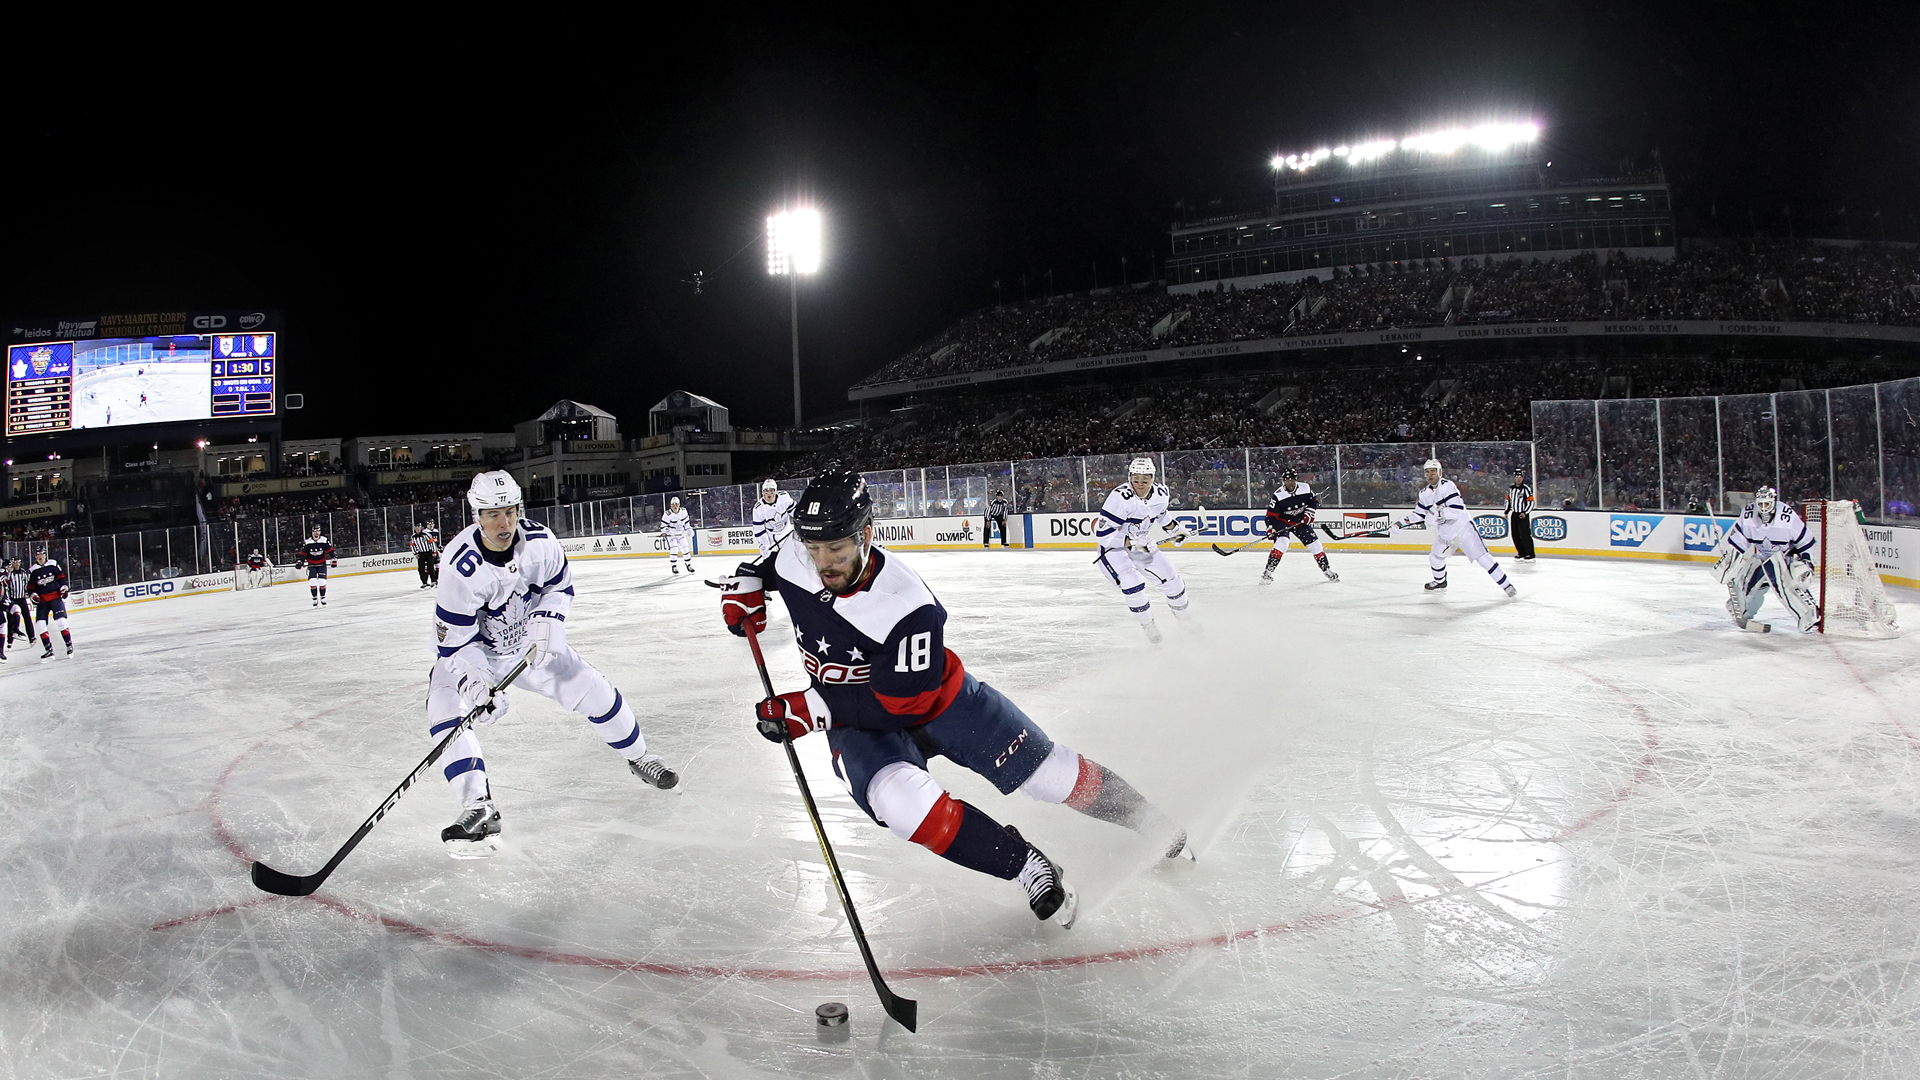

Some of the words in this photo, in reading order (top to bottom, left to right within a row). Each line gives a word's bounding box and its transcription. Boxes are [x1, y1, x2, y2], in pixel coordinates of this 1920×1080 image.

[100, 314, 158, 325] NAVY-MARINE
[160, 313, 187, 323] CORPS
[193, 316, 226, 328] GD
[58, 321, 80, 330] Navy
[100, 326, 146, 338] MEMORIAL
[148, 324, 185, 335] STADIUM
[1494, 327, 1532, 336] MISSILE
[1536, 326, 1568, 334] CRISIS
[1604, 325, 1645, 333] MEKONG
[24, 328, 52, 338] leidos
[64, 328, 95, 338] Mutual
[1380, 333, 1422, 341] LEBANON
[1301, 338, 1344, 346] PARALLEL
[1216, 345, 1240, 354] SIEGE
[264, 363, 270, 372] 5
[1076, 360, 1102, 368] CHOSIN
[1106, 355, 1147, 365] RESERVOIR
[215, 364, 221, 374] 2
[232, 363, 253, 373] 1:30
[300, 479, 329, 488] GEICO
[494, 478, 505, 486] 16
[16, 506, 52, 516] HONDA
[807, 502, 820, 515] 18
[1744, 504, 1754, 519] 35
[1780, 506, 1793, 522] 35
[1174, 516, 1268, 536] GEICO
[1346, 521, 1388, 529] CHAMPION
[1478, 517, 1504, 526] ROLD
[1537, 518, 1563, 527] ROLD
[519, 518, 549, 542] 16
[873, 526, 914, 541] ANADIAN
[1477, 526, 1506, 536] GOLD
[1534, 526, 1563, 537] GOLD
[1611, 520, 1652, 542] SAP
[1684, 523, 1724, 546] SAP
[936, 532, 973, 542] OLYMPIC
[1869, 546, 1899, 559] ARDS
[362, 556, 414, 568] ticketmaster
[449, 543, 483, 577] 16
[191, 577, 216, 589] Coors
[217, 576, 234, 585] LIGH
[124, 582, 174, 598] GEICO
[528, 610, 565, 622] TRUE
[504, 626, 525, 640] MAPLE
[503, 635, 521, 647] LEAF
[894, 631, 931, 673] 18
[798, 645, 871, 685] aps
[994, 728, 1028, 768] CCM
[365, 756, 432, 827] TRUE
